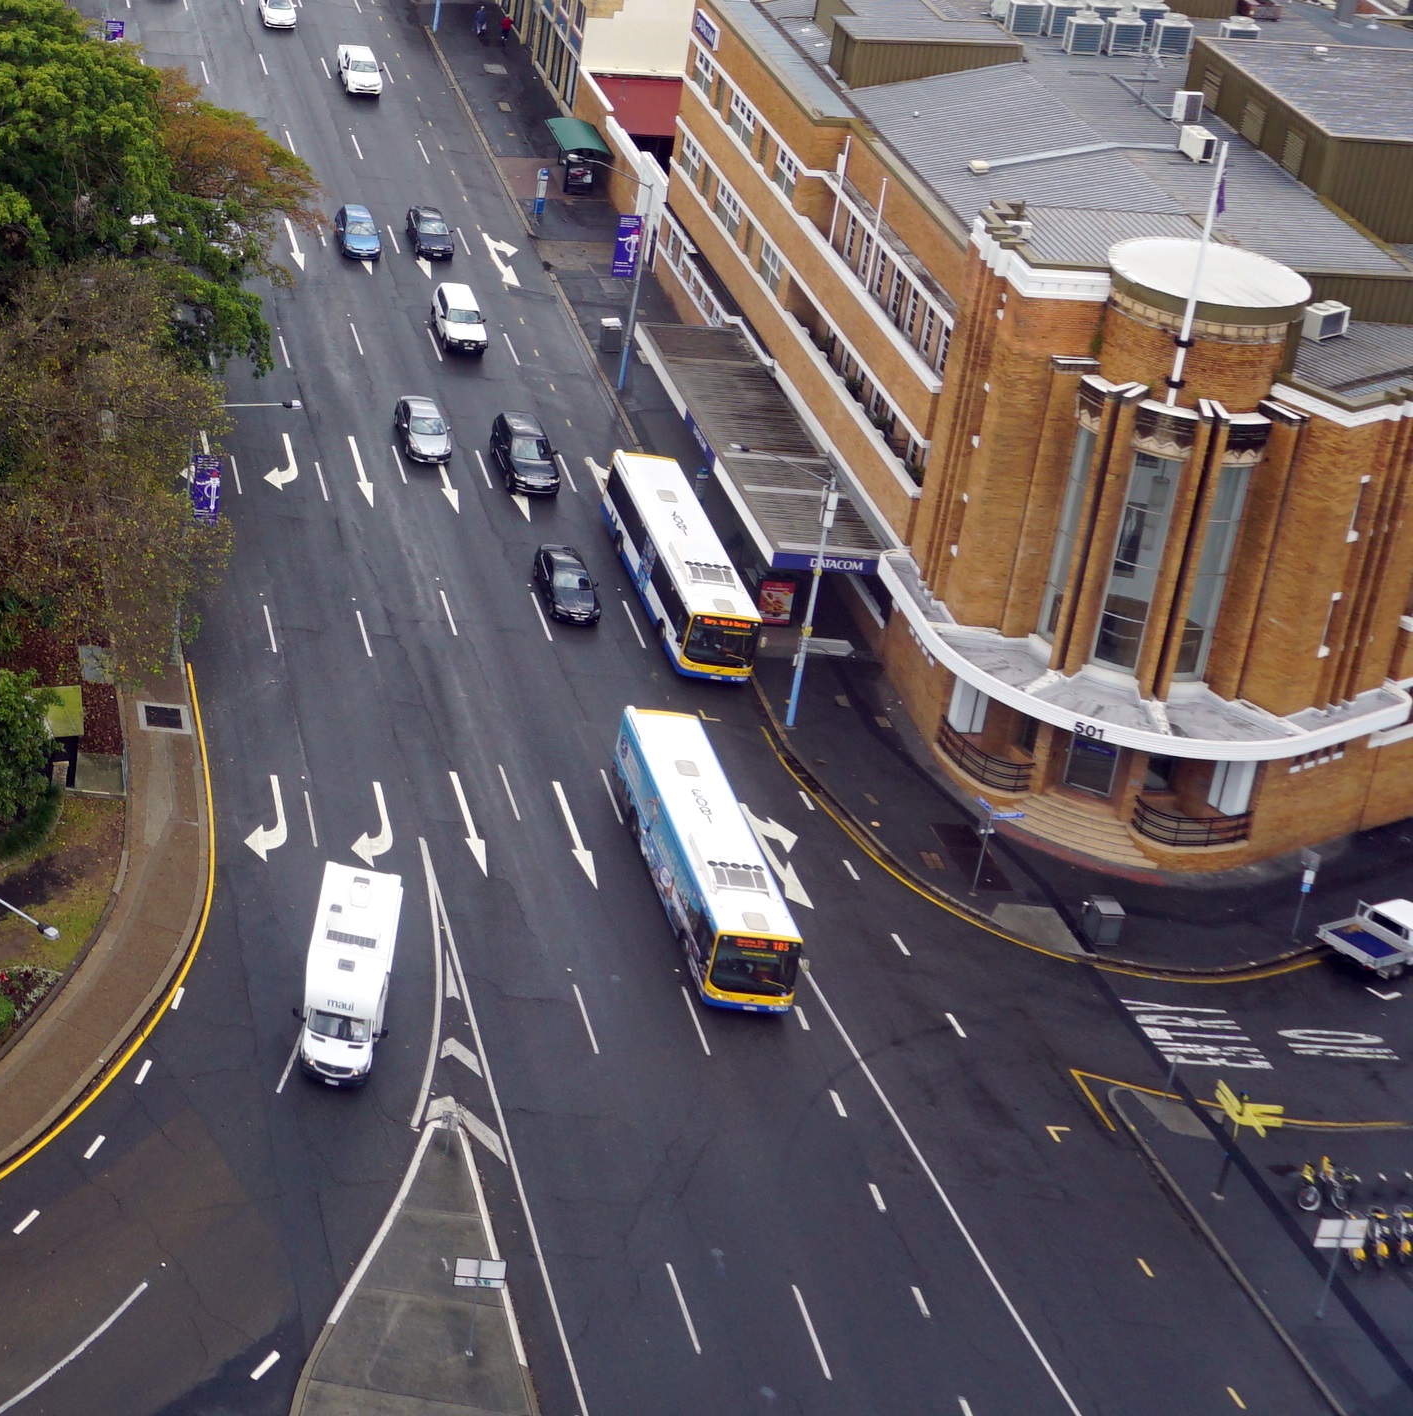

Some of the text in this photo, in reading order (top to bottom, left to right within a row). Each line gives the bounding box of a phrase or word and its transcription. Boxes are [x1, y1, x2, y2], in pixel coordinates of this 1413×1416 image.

[810, 558, 863, 571] DATACOM
[1073, 721, 1105, 740] 501
[772, 941, 790, 952] 185
[327, 999, 355, 1012] maui
[1119, 999, 1274, 1070] ENTRY
[1277, 1029, 1401, 1061] NO
